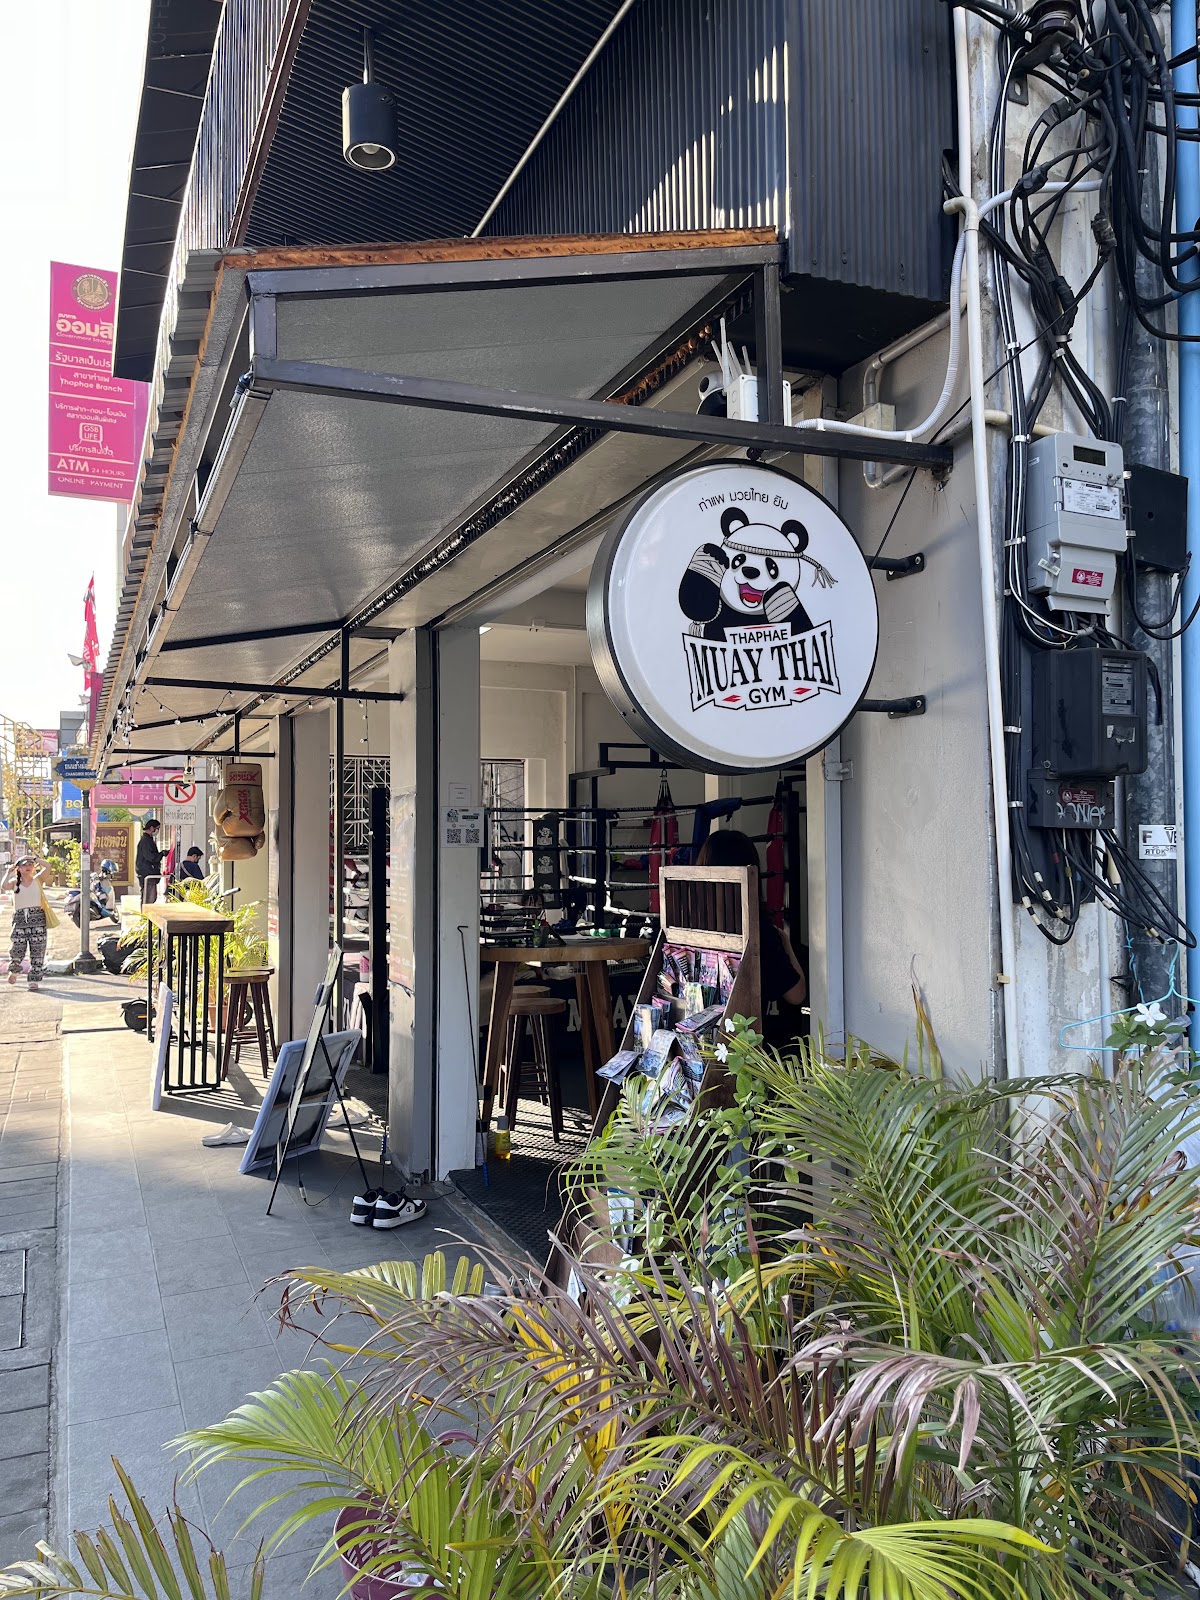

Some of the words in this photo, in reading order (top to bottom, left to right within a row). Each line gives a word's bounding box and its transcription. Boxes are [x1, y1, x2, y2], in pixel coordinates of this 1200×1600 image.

[56, 318, 113, 339] ออมสิ
[55, 351, 111, 368] รัฐบาลเป็นปร
[60, 377, 94, 389] Thaphae
[95, 383, 123, 393] Branch
[83, 425, 99, 433] GSB
[56, 458, 90, 473] ATM
[101, 469, 125, 477] HOURS
[57, 477, 85, 485] ONLINE
[90, 480, 124, 489] PAYMENT
[698, 493, 725, 512] ท่าแพ
[729, 487, 769, 504] มวยไทย
[773, 495, 789, 510] ยิม
[730, 629, 789, 645] THAPHAE
[689, 642, 764, 702] MUAY
[770, 630, 835, 686] THAI
[748, 686, 786, 704] GYM
[140, 776, 164, 790] AT
[65, 799, 83, 809] BO
